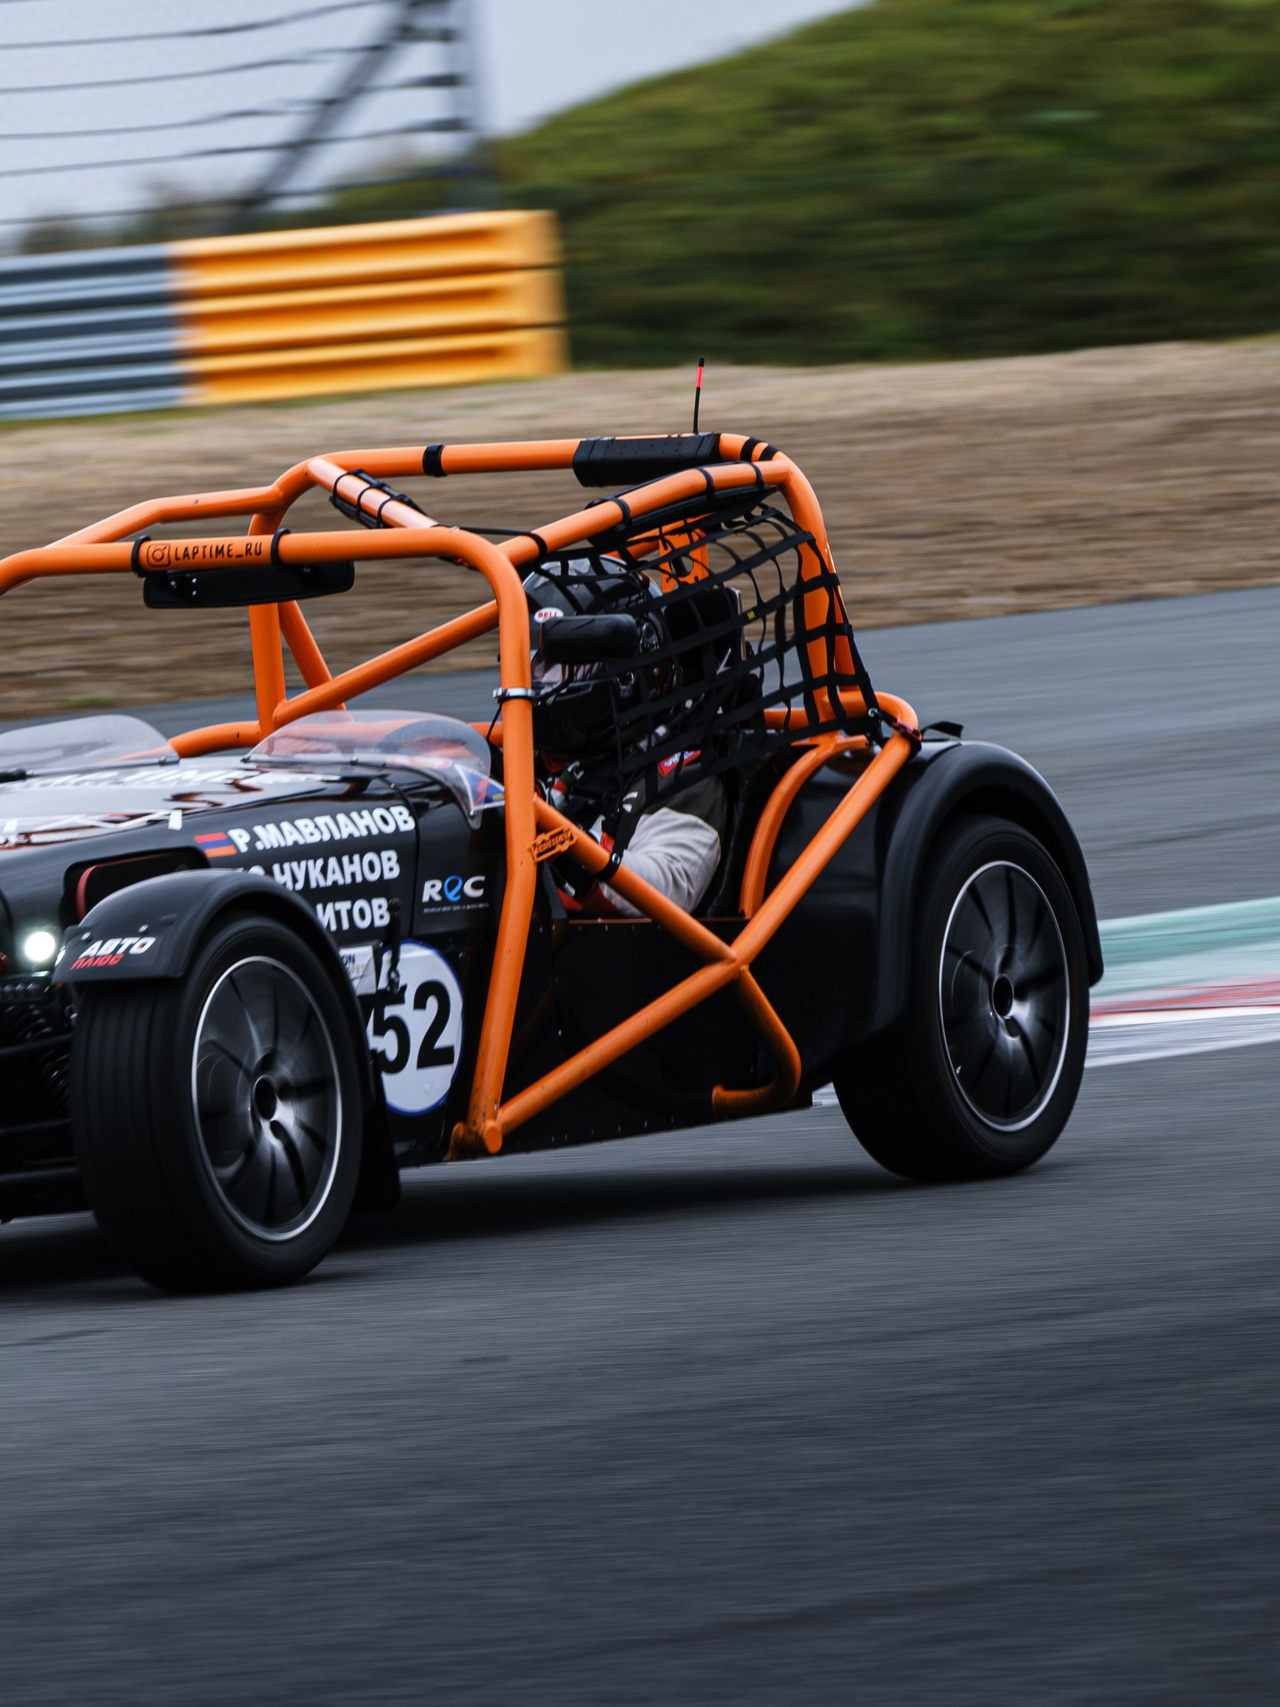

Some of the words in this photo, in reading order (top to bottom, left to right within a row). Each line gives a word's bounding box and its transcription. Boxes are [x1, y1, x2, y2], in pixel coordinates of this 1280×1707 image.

[174, 541, 263, 562] LAPTIME_RU
[227, 805, 416, 853] Р.МАВЛАНОВ
[248, 850, 400, 891] ЧУКАНОВ
[79, 937, 156, 958] АВТО
[370, 978, 455, 1076] 52
